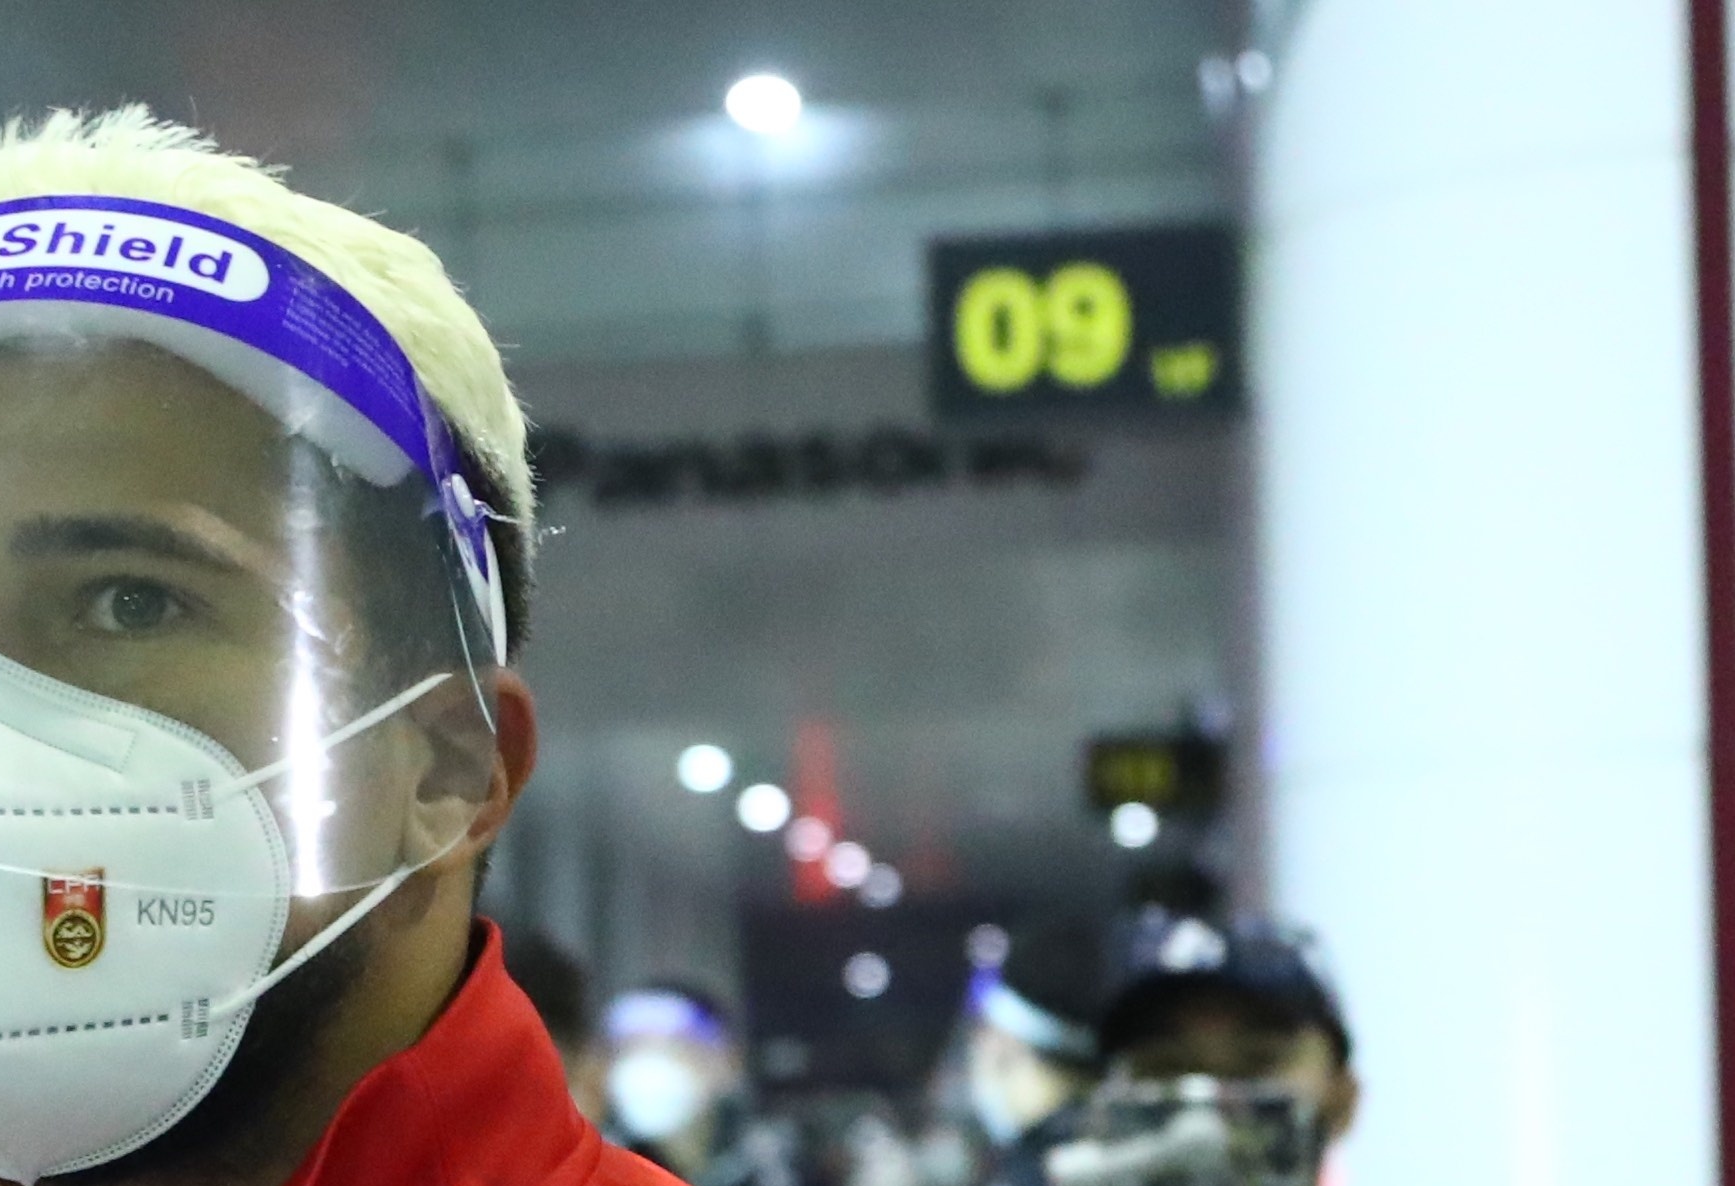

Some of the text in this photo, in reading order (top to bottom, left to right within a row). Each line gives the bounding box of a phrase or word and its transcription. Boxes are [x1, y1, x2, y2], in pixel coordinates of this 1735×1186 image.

[24, 271, 175, 303] protection
[954, 261, 1130, 393] 09
[137, 898, 216, 927] KN95
